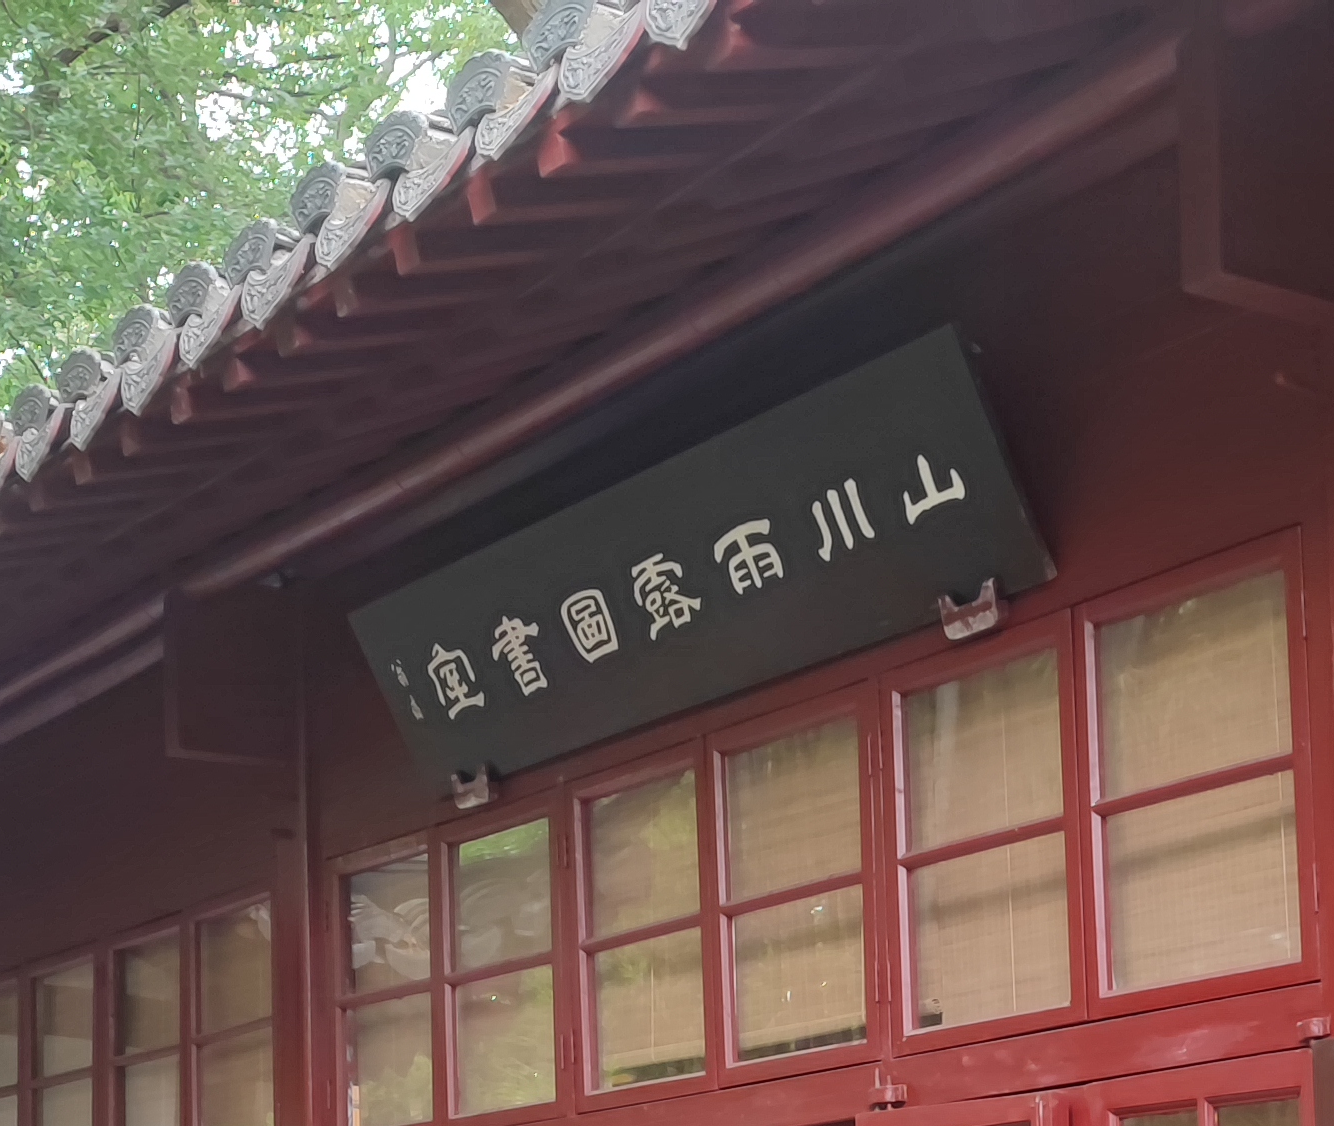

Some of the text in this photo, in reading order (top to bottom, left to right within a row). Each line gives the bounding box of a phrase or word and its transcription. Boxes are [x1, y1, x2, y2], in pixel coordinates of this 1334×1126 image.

[427, 454, 967, 720] 山川雨露圖書室
